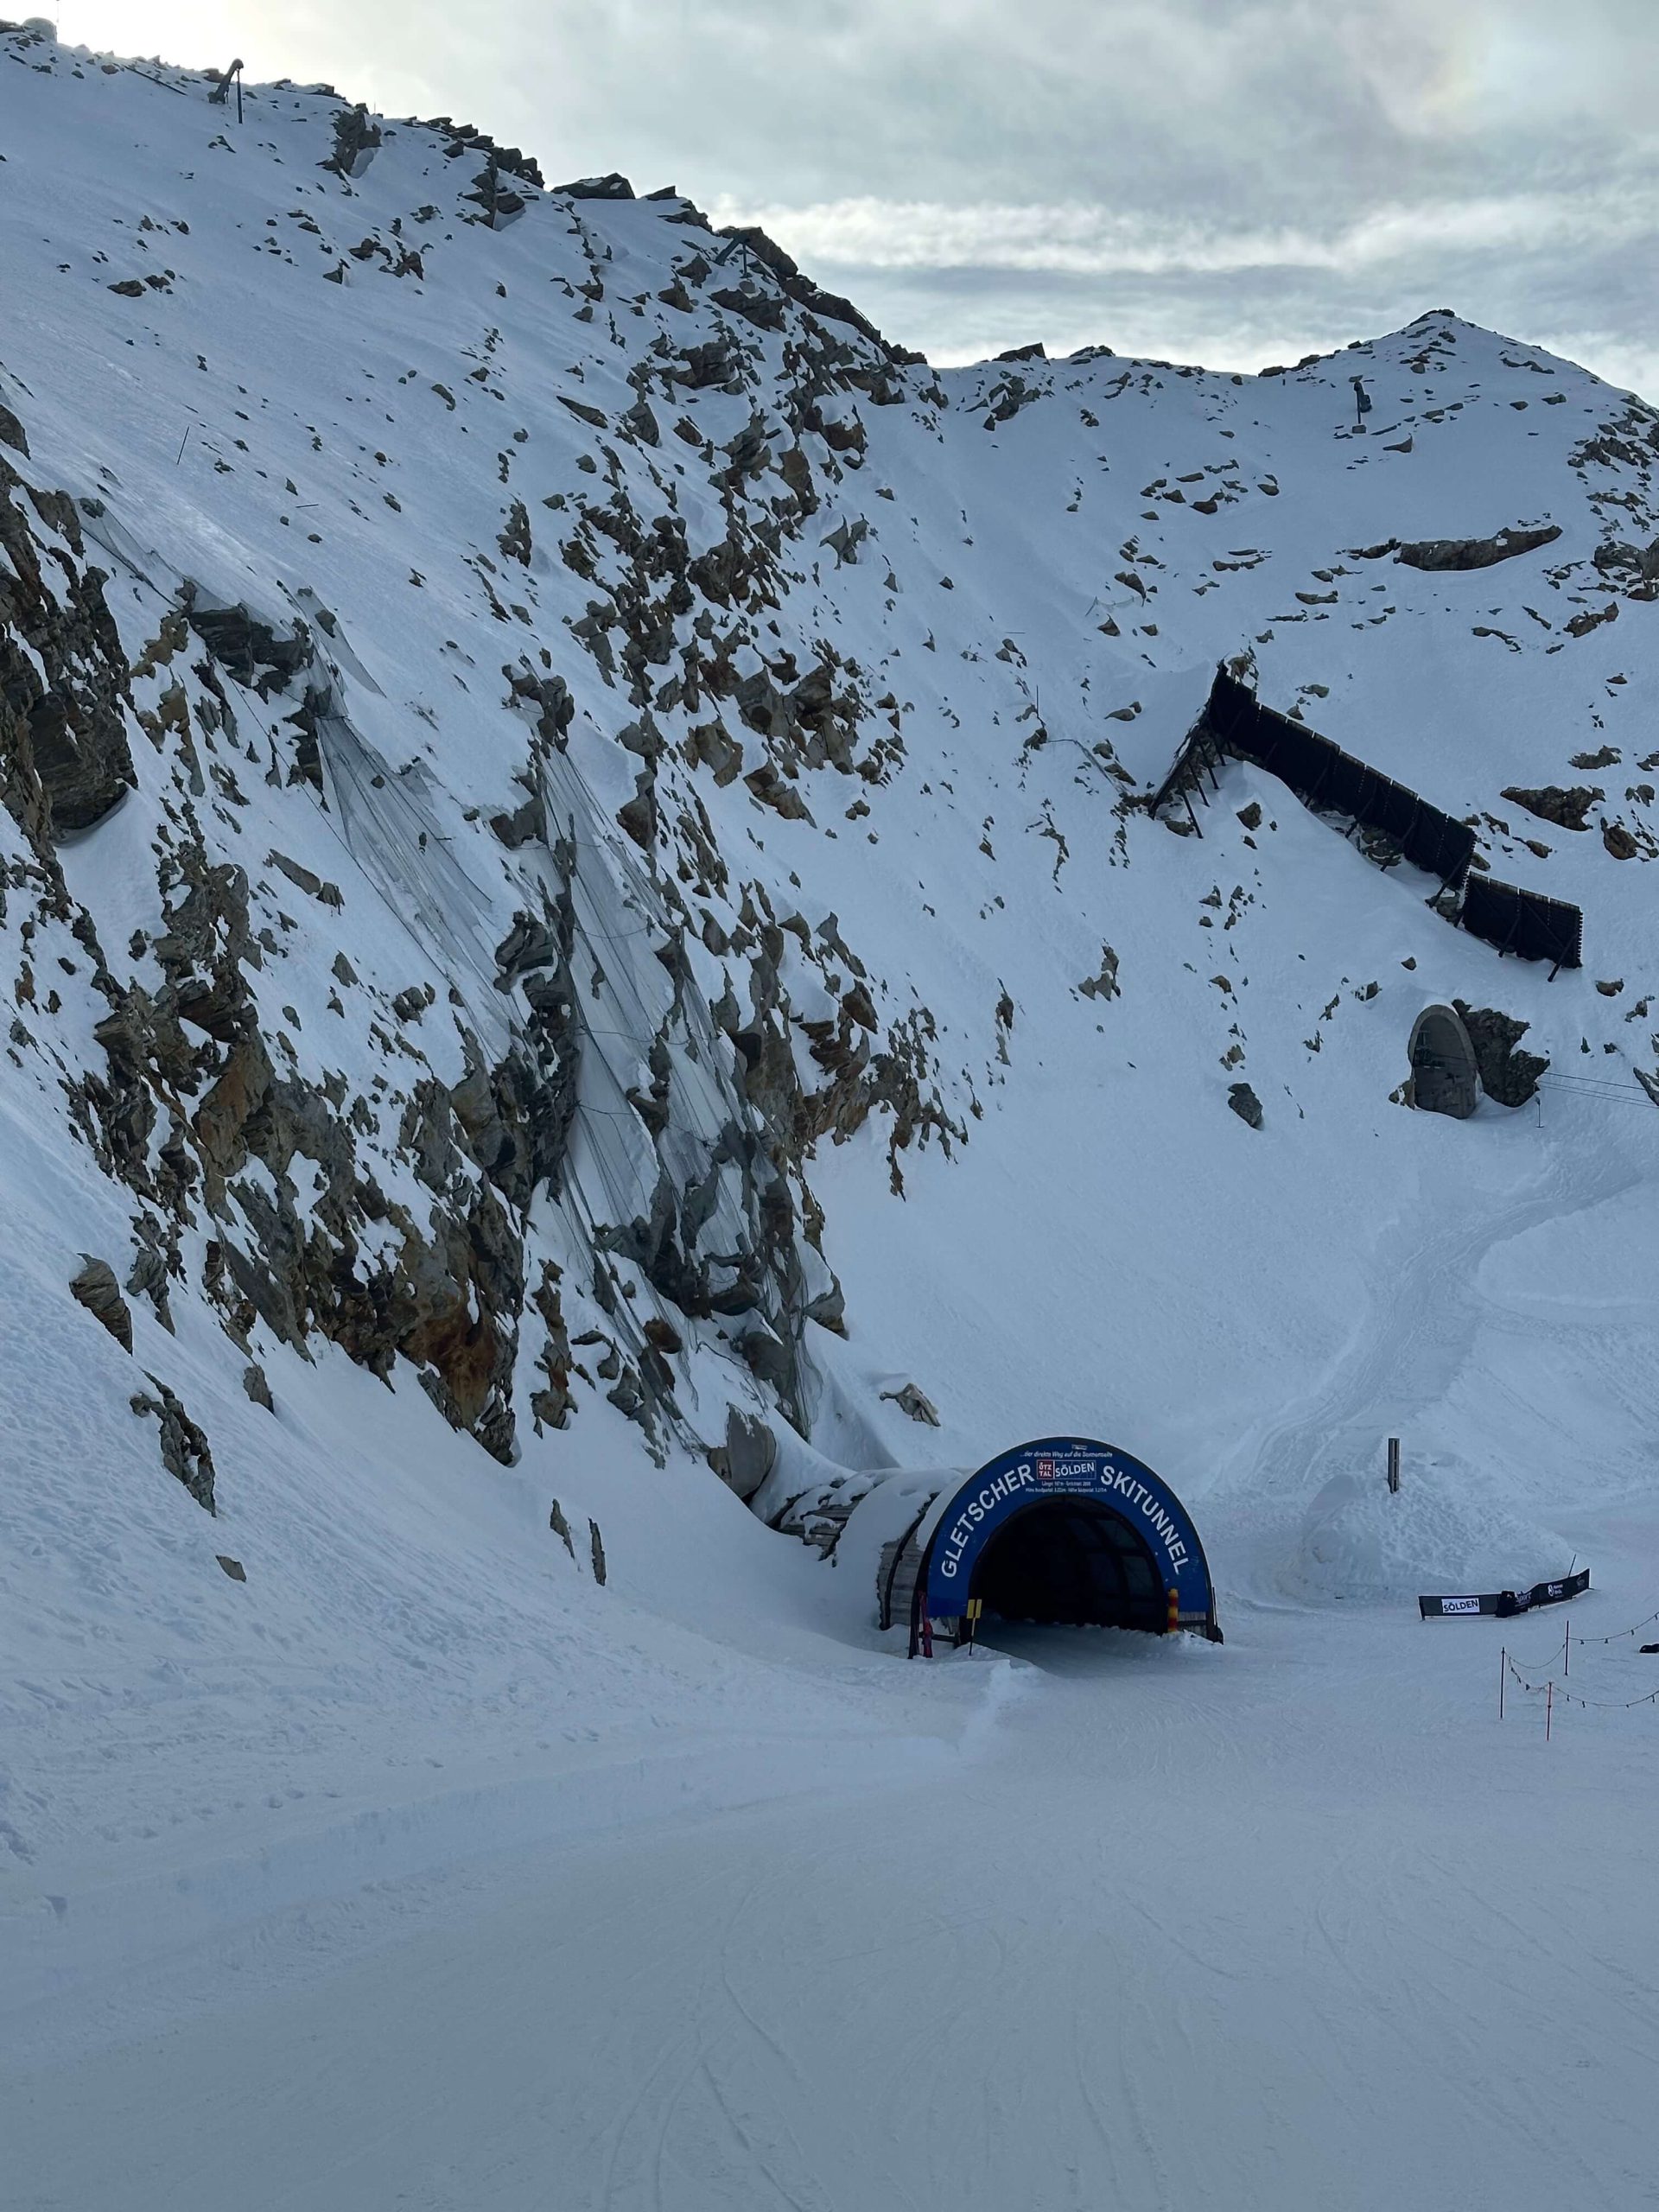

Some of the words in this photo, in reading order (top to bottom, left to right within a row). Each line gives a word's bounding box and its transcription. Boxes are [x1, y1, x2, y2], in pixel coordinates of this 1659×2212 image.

[1039, 1462, 1052, 1471] ÖTZ
[1055, 1462, 1095, 1478] SÖLDEN
[941, 1464, 1035, 1579] GLETSCHER
[1101, 1465, 1190, 1574] SKITUNNEL
[1443, 1599, 1479, 1612] SÖLDEN
